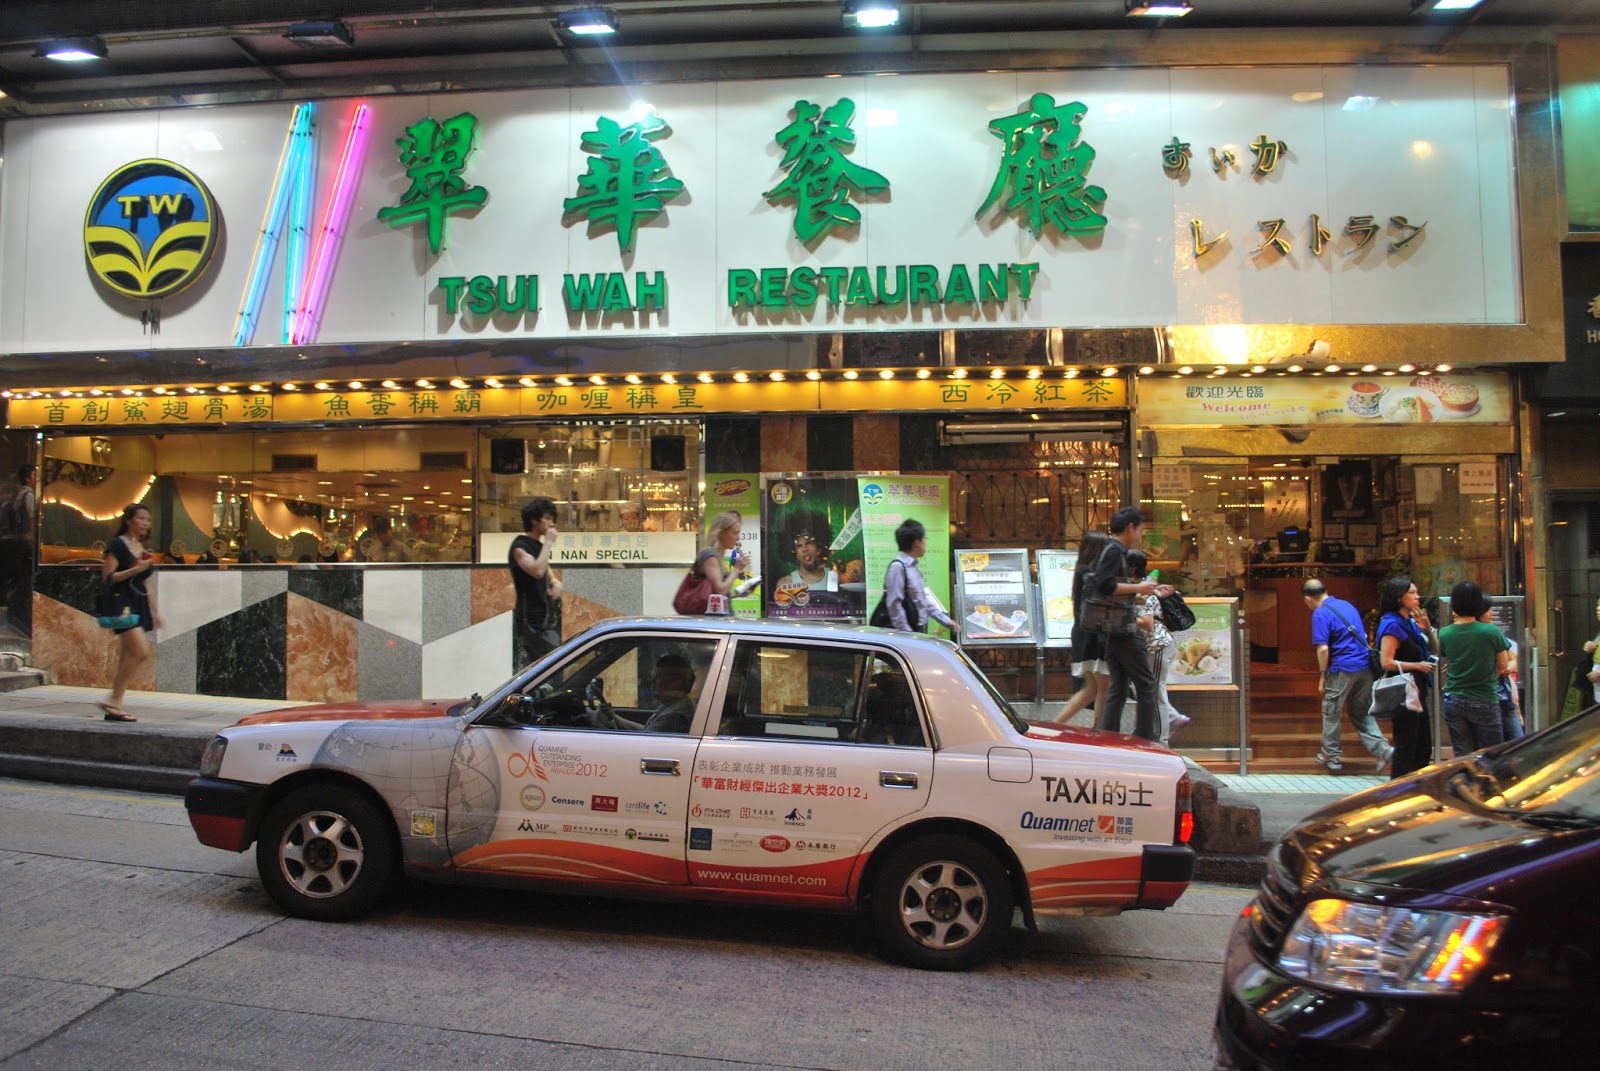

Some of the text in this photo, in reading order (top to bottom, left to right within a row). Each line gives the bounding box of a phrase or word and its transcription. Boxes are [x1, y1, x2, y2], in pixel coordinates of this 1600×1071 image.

[377, 92, 1108, 254] 翠華餐廳
[117, 193, 183, 216] TW
[1190, 212, 1429, 257] レストラン
[438, 262, 1040, 314] TSUI WAH RESTAURANT
[536, 386, 703, 411] 咖喱稱皇
[939, 380, 1115, 404] 西冷紅茶
[1185, 386, 1264, 398] 歡迎光臨
[44, 397, 272, 423] 首創鯊翅骨湯
[324, 390, 482, 417] 魚蛋稱霸
[1201, 402, 1271, 413] Welcome
[561, 550, 588, 560] NAN
[596, 549, 649, 560] SPECIAL
[538, 745, 568, 754] QUAMNET
[540, 753, 582, 762] OUTSTANDING
[543, 760, 575, 769] ENTERPRISE
[549, 763, 608, 778] AWARDS 2012
[698, 760, 838, 778] 表彰企業成就 推動業務發展
[1040, 776, 1153, 807] TAXI 的士
[551, 796, 585, 806] Censere
[625, 801, 650, 810] cordlife
[1020, 811, 1095, 833] Quamnet
[1116, 816, 1133, 826] 華富
[1053, 833, 1086, 842] Investing
[1087, 835, 1103, 843] with
[1114, 836, 1132, 844] Edge
[1116, 826, 1133, 835] 財經
[698, 869, 827, 887] www.quamnet.com
